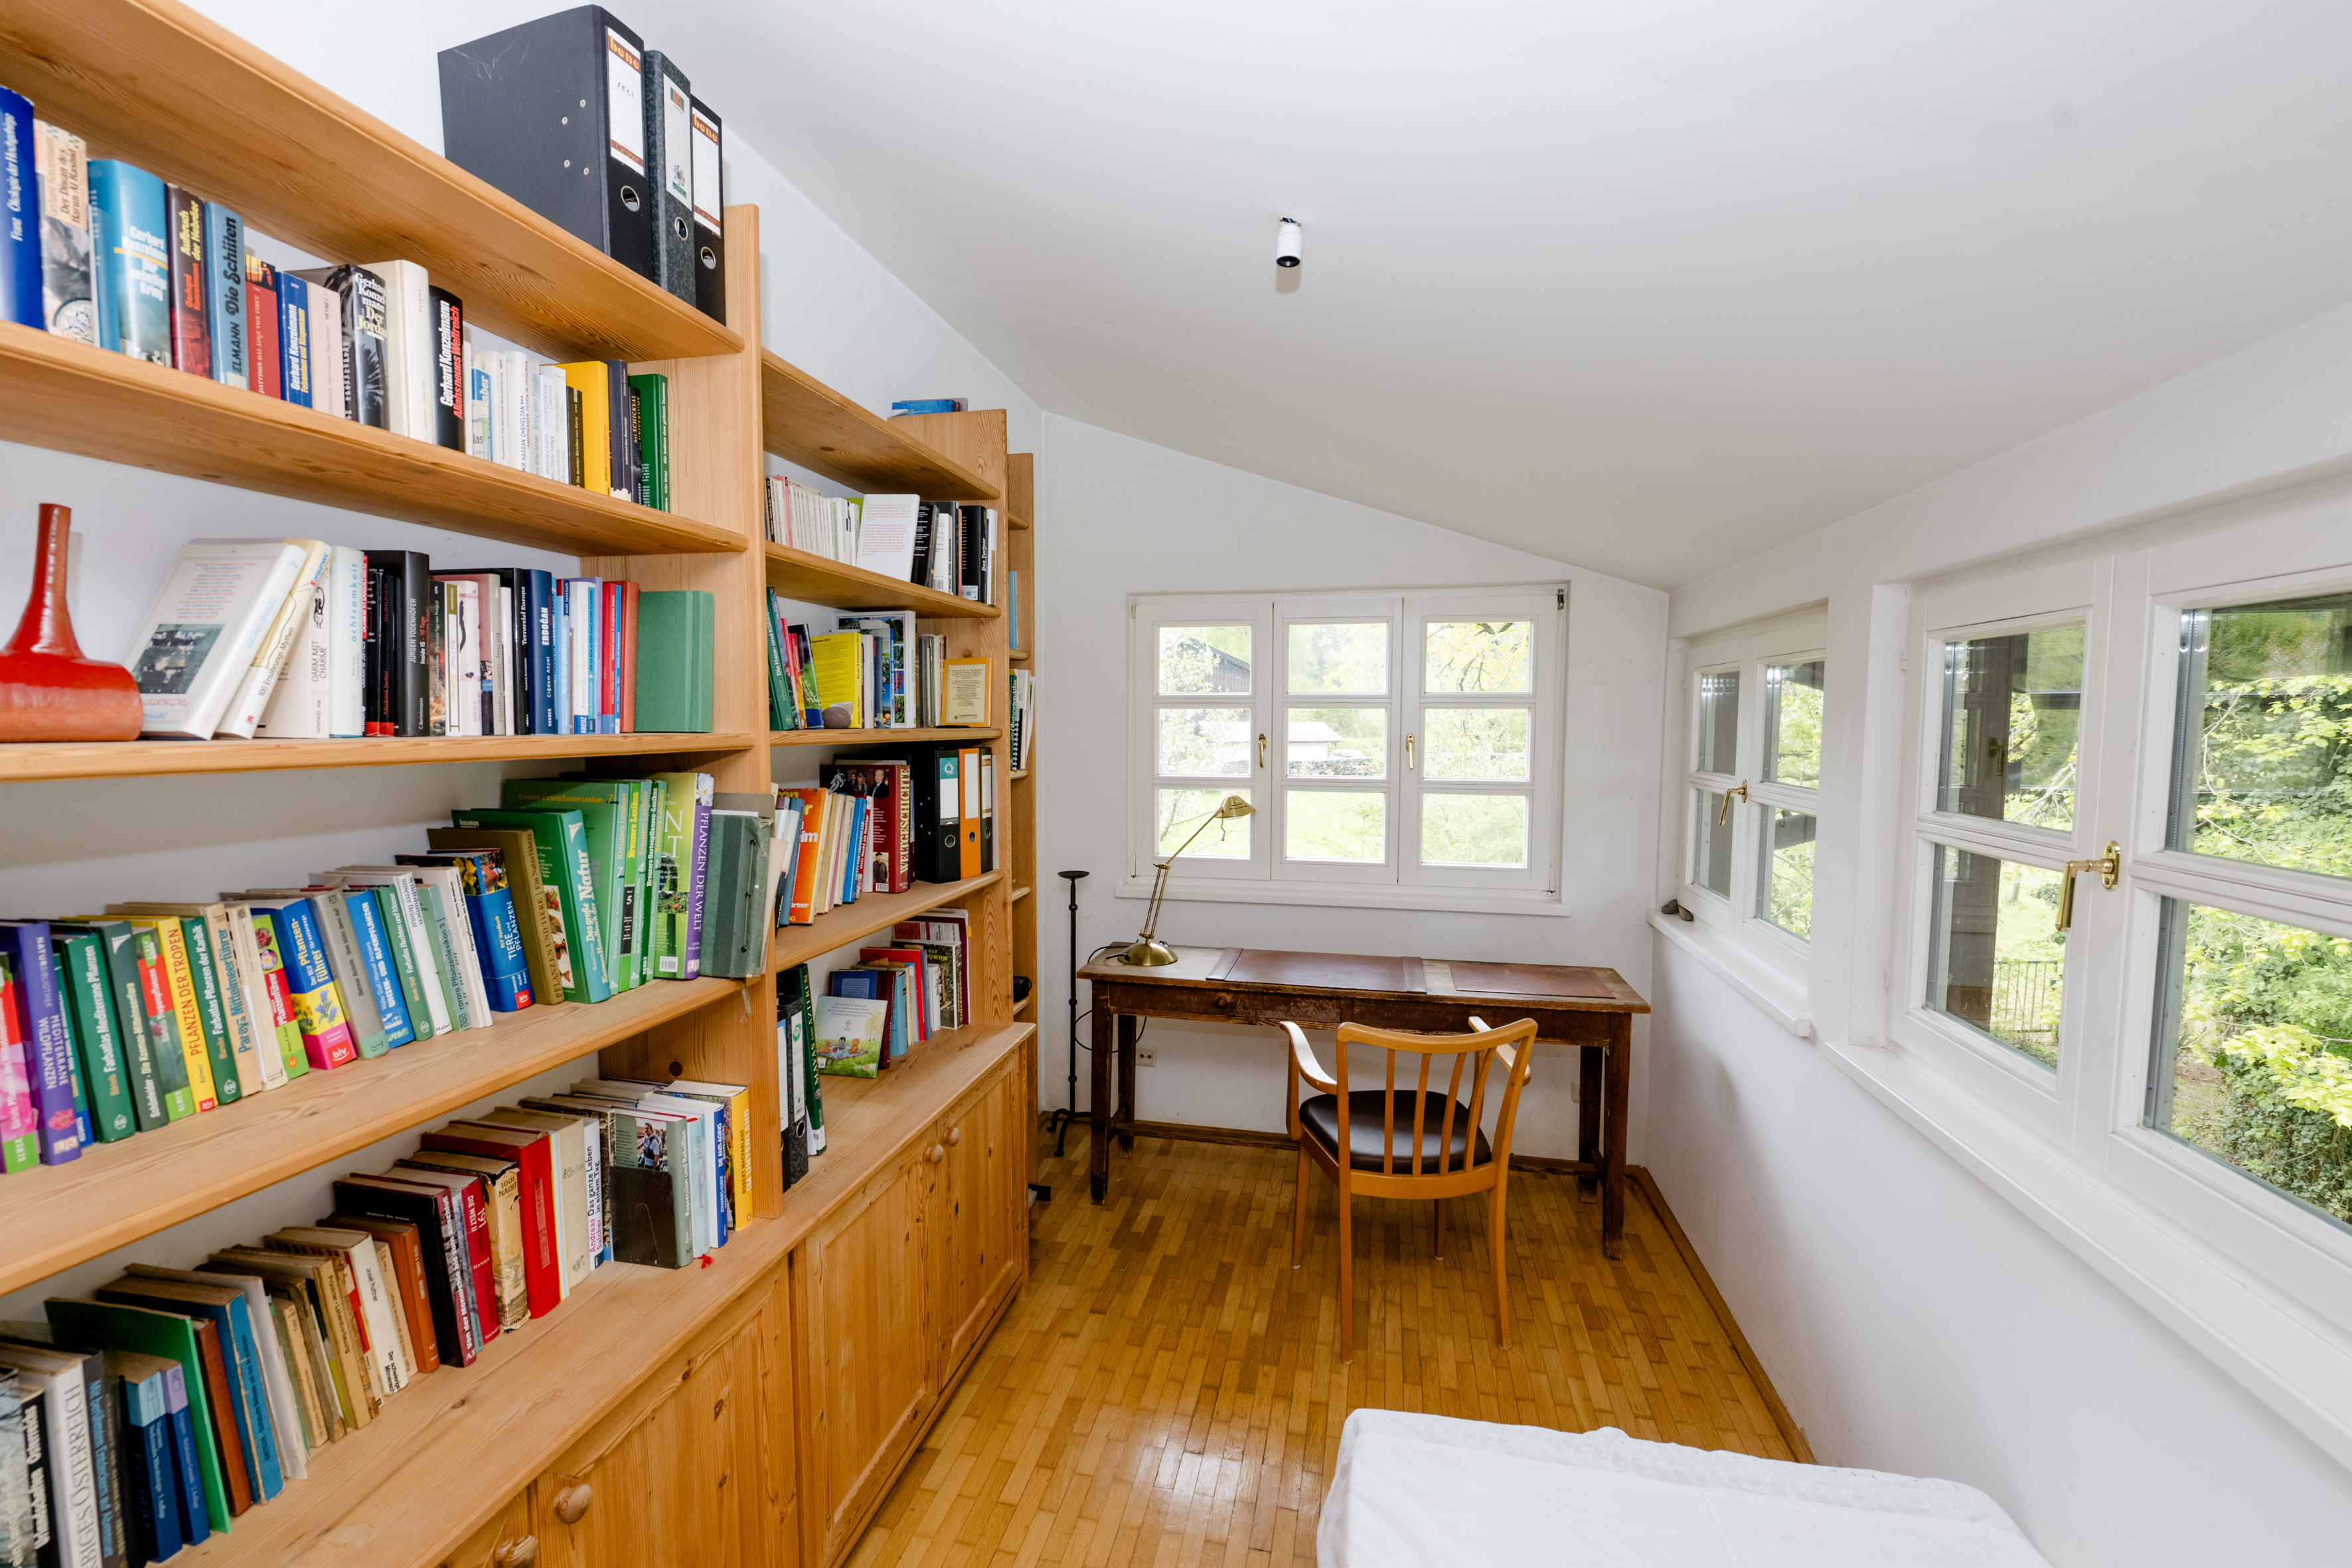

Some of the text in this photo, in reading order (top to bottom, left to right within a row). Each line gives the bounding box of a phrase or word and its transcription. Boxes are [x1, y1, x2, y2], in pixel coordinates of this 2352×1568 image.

[609, 36, 641, 70] bene
[693, 113, 718, 143] bene
[615, 142, 641, 164] Ordner
[222, 216, 240, 316] Die Schiiten
[362, 297, 385, 313] mann
[364, 305, 384, 325] Der
[288, 303, 301, 390] Gerhard Konzelmann
[438, 299, 454, 408] Gerhard Konzelmann
[449, 305, 464, 420] Allahs neues Weltreich
[299, 357, 309, 394] Felsendom
[539, 607, 550, 646] ERDOĞAN
[318, 645, 327, 679] CHARME
[542, 795, 582, 803] Gartenpflanzen
[629, 791, 639, 823] Lexikon
[900, 769, 909, 874] WELTGESCHICHTE
[525, 832, 536, 876] Naturführer
[617, 824, 625, 860] Kreuzers
[455, 874, 467, 907] Lebensraum
[693, 813, 709, 932] PFLANZEN DER WELT
[401, 878, 417, 927] unserer Heimat
[537, 898, 547, 926] TIERE
[577, 849, 595, 942] Das große Natur
[291, 918, 310, 966] Pflanzen-
[389, 892, 413, 973] Farbatlas Flechten Moose
[464, 915, 477, 951] Alpenpflanzen
[507, 901, 522, 951] PFLANZEN
[542, 927, 551, 947] UND
[311, 949, 328, 982] führer
[362, 902, 396, 1008] WIESEN- UND ALPENPFLANZEN
[442, 929, 459, 987] Pflanzenlexikon
[504, 932, 516, 961] TIERE
[193, 924, 223, 1035] Farbatlas Pflanzen der Karibik
[305, 965, 314, 977] BLV
[547, 947, 562, 998] PFLANZEN
[85, 945, 116, 1073] Farbatlas Mediterrane Pflanzen
[168, 928, 201, 1056] PFLANZEN DER TROPEN
[218, 928, 251, 1054] Pareys Mittelmeerführer
[268, 973, 287, 1026] Pflanzenführer
[455, 987, 464, 1010] rororo
[803, 974, 813, 1025] AZTEKEN
[38, 1016, 56, 1090] WILDPFLANZEN
[50, 1014, 69, 1086] MEDITERRANE
[332, 1047, 347, 1059] blv
[809, 1042, 819, 1085] MAYAS
[584, 1146, 593, 1172] Leben
[499, 1181, 520, 1198] NACHT
[501, 1176, 517, 1188] 1001
[587, 1172, 596, 1198] ganze
[683, 1178, 692, 1217] Repression
[746, 1177, 752, 1191] IM
[442, 1196, 455, 1236] Anschluß
[469, 1207, 477, 1225] WELT
[449, 1235, 459, 1255] zum
[451, 1255, 459, 1271] bis
[366, 1268, 374, 1283] Josef
[455, 1271, 467, 1316] Monarchie
[65, 1383, 90, 1507] ÖSTERREICH
